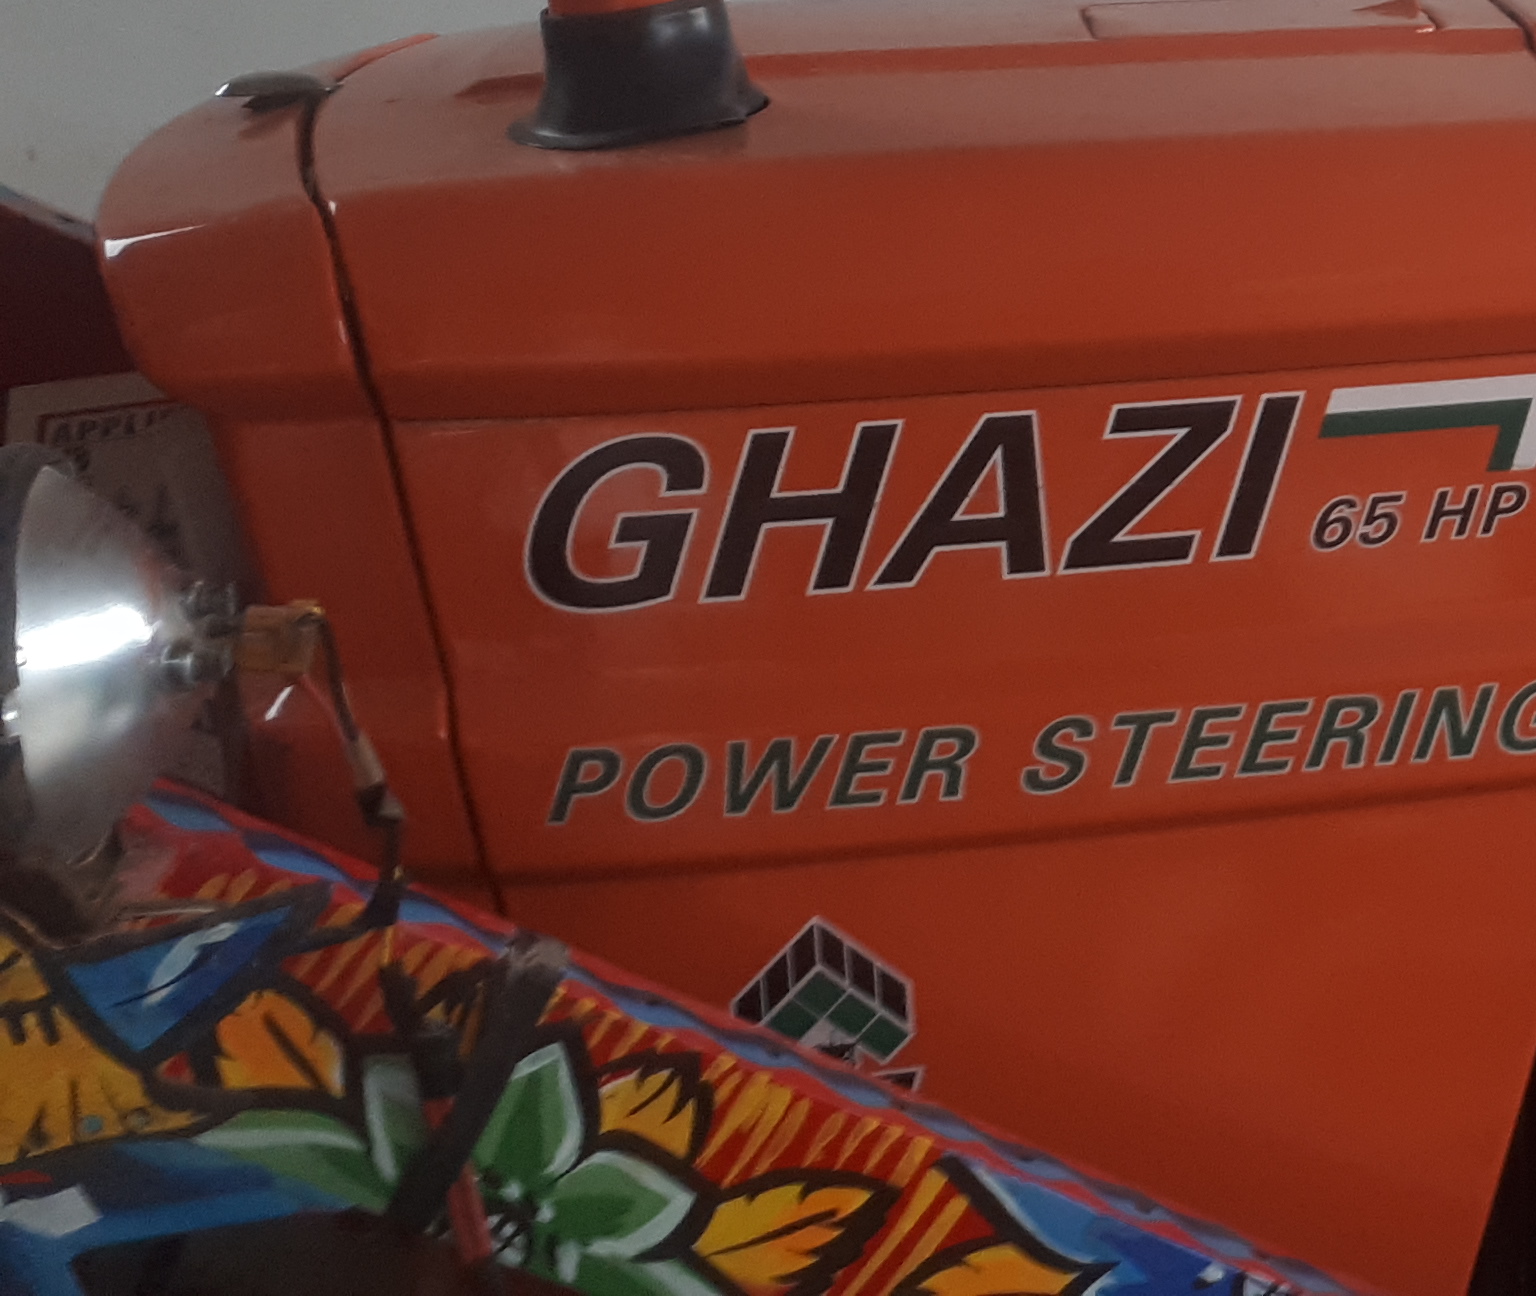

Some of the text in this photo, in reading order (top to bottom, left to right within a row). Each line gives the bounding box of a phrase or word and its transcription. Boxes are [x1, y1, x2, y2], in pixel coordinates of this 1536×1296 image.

[523, 390, 1306, 613] GHAZI
[1310, 482, 1528, 553] 65 HP
[547, 724, 980, 823] POWER
